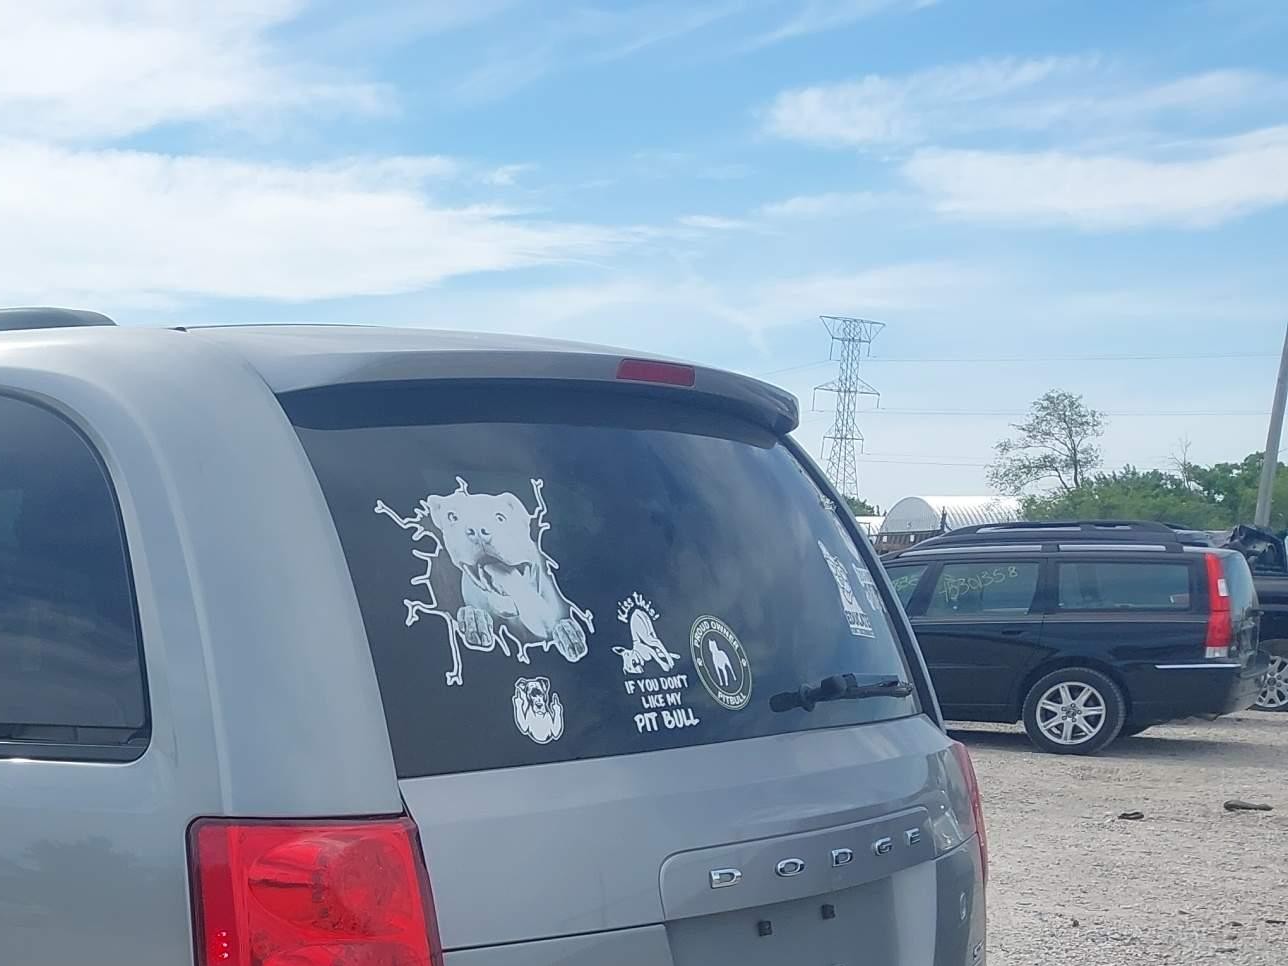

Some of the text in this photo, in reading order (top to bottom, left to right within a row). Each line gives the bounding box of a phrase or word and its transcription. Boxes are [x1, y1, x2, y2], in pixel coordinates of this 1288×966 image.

[694, 620, 740, 650] PROUD OWNER
[624, 680, 636, 694] IF
[637, 677, 659, 692] YOU
[641, 691, 682, 709] LIKE MY
[717, 691, 747, 706] PITBULL
[633, 708, 700, 733] PIT BULL
[710, 827, 921, 889] DODGE
